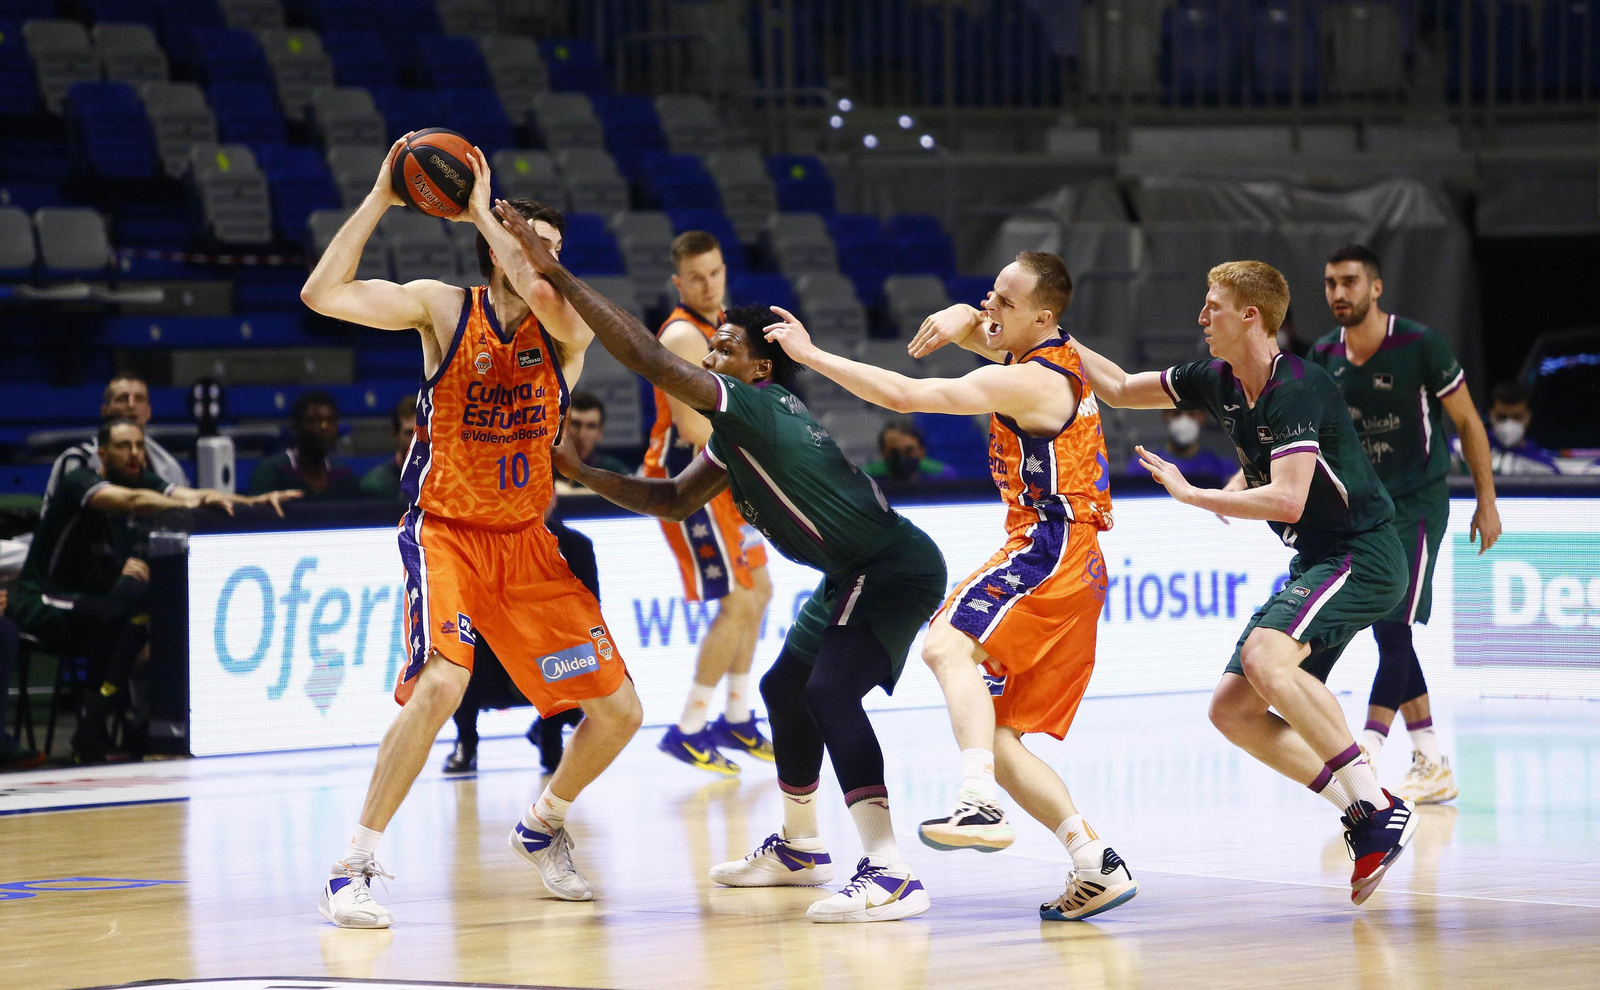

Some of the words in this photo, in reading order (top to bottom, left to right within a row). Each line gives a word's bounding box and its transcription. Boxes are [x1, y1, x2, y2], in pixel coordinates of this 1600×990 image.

[466, 381, 532, 406] Cultura
[496, 452, 530, 490] 10
[542, 655, 597, 678] Midea
